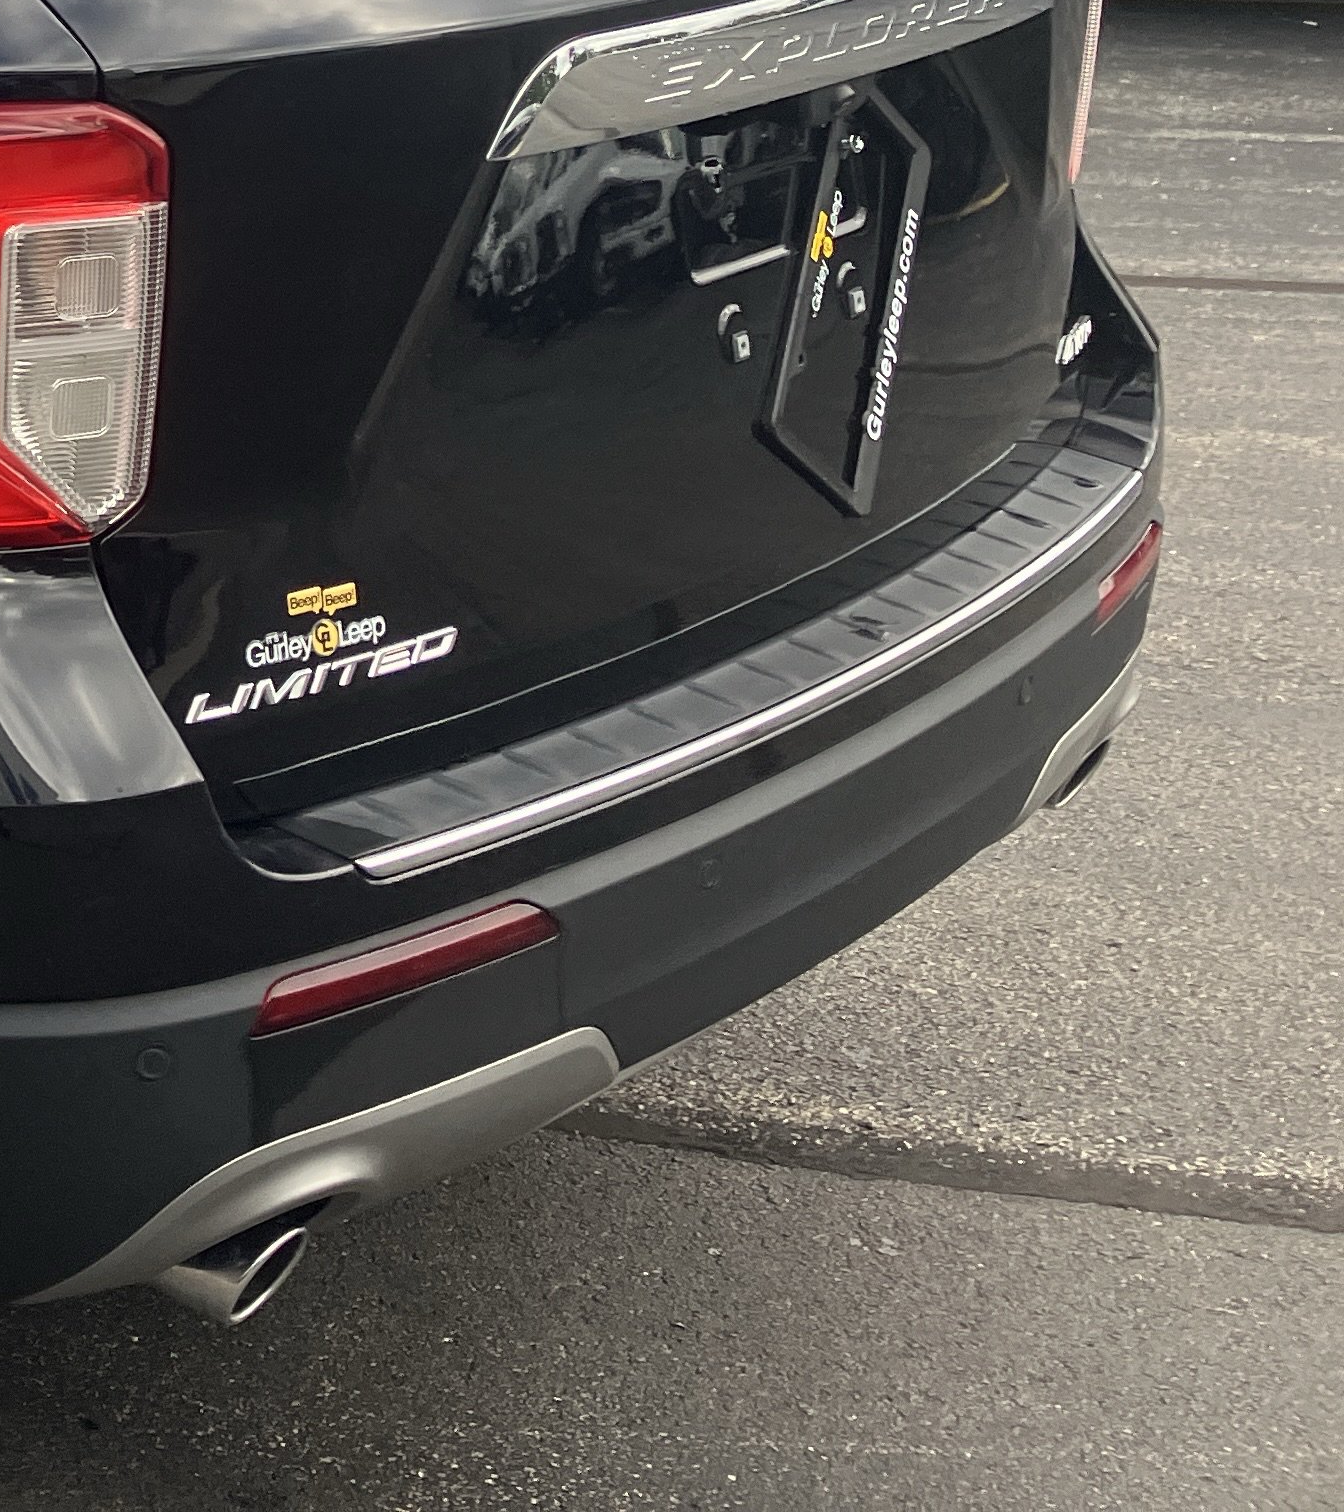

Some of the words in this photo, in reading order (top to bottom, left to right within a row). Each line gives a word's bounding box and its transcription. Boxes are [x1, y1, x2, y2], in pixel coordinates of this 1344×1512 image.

[866, 208, 920, 442] Gurleyleep.com
[184, 625, 459, 725] LIMITED
[335, 615, 386, 646] Leep
